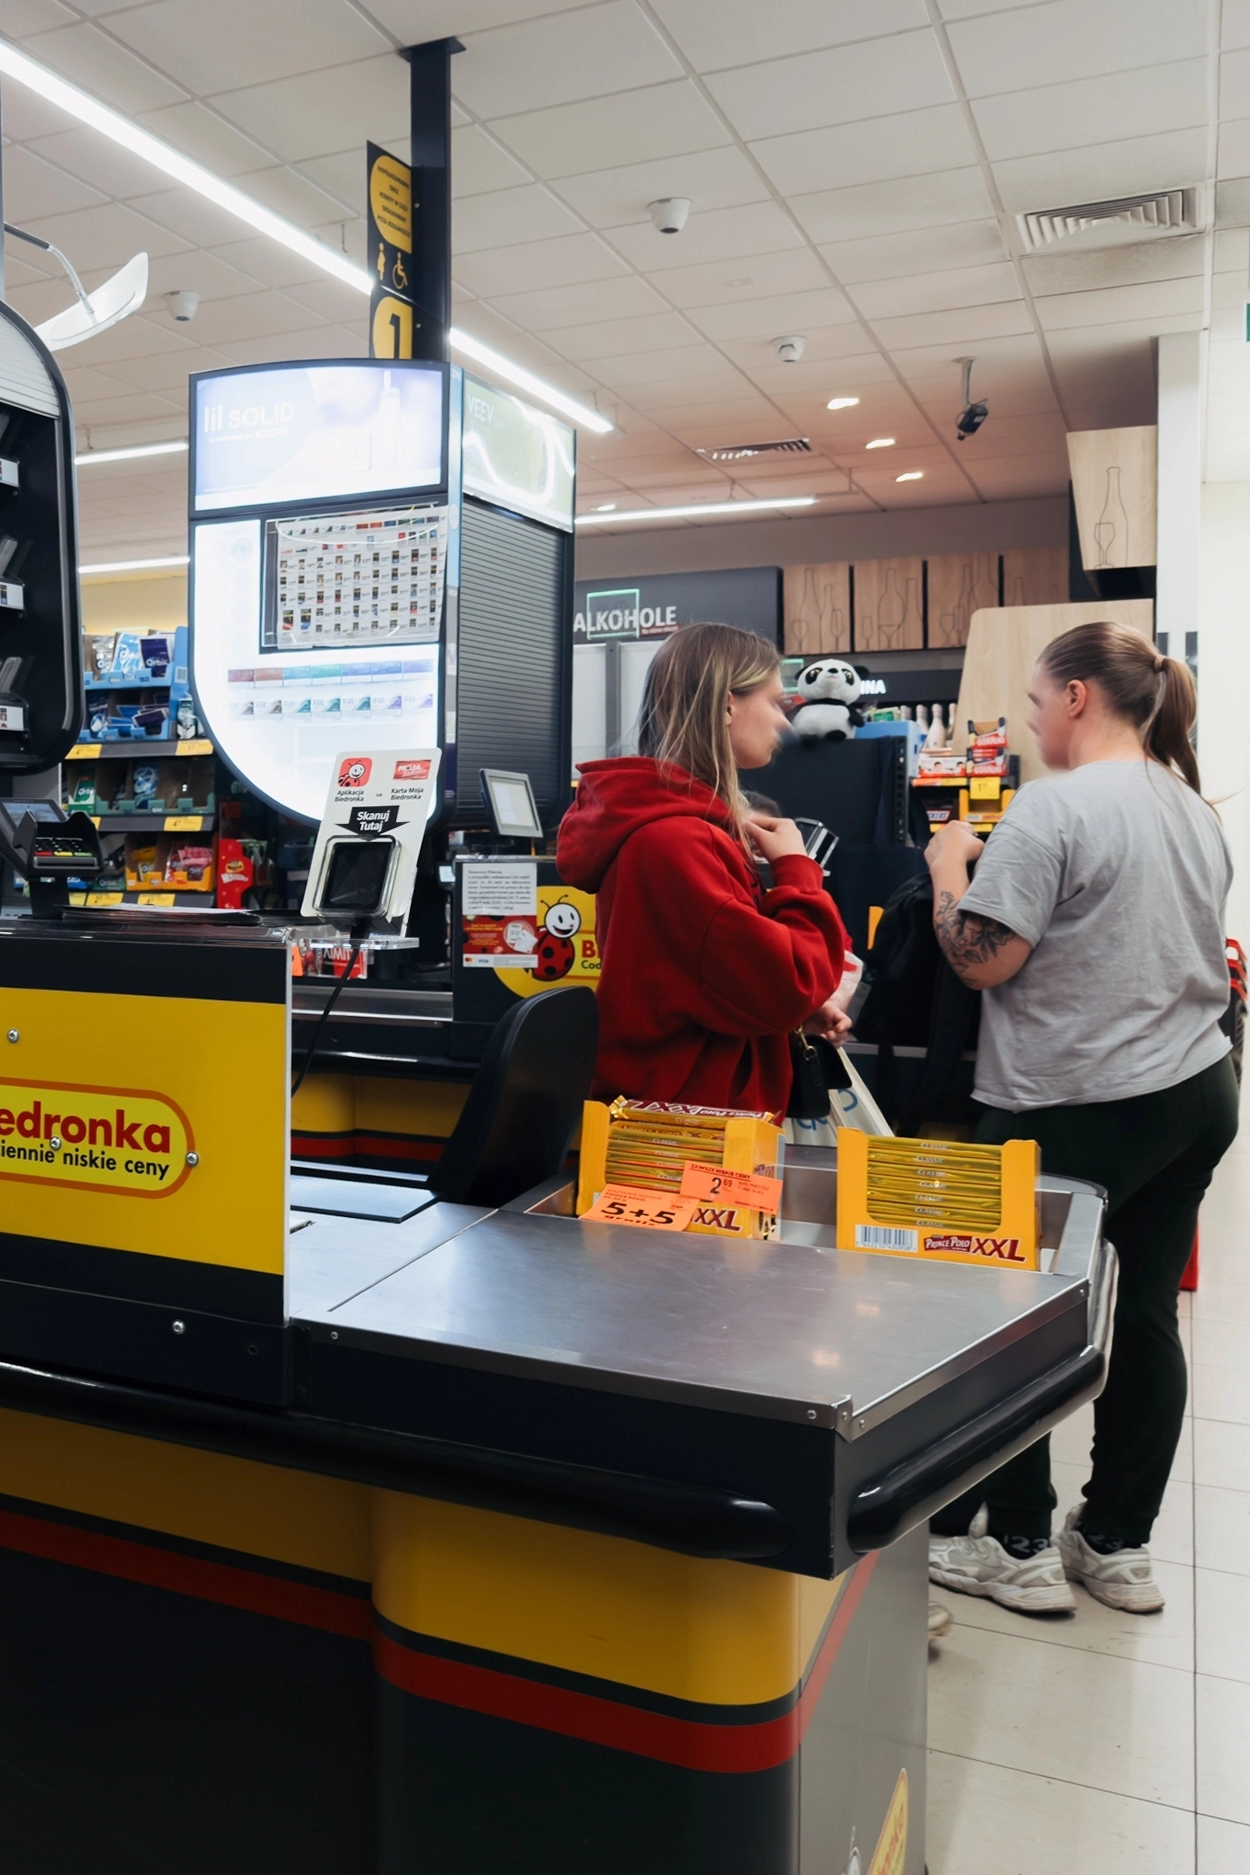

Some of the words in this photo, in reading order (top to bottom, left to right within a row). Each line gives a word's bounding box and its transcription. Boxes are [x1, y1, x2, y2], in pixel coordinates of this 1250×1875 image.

[389, 312, 401, 360] 1
[228, 400, 296, 430] SOLID
[573, 605, 677, 633] ALKOHOLE
[860, 680, 886, 695] INA
[337, 789, 364, 797] Aplikacja
[356, 809, 391, 822] Skanuj
[359, 821, 383, 832] Tutaj
[63, 1148, 117, 1171] niskie
[124, 1159, 170, 1181] ceny
[915, 1155, 945, 1164] CLASSIC
[694, 1208, 742, 1232] XXL
[916, 1219, 945, 1229] CLASSIC
[925, 1237, 950, 1251] PRINCE
[950, 1236, 971, 1249] POLO
[971, 1237, 1027, 1263] XXL
